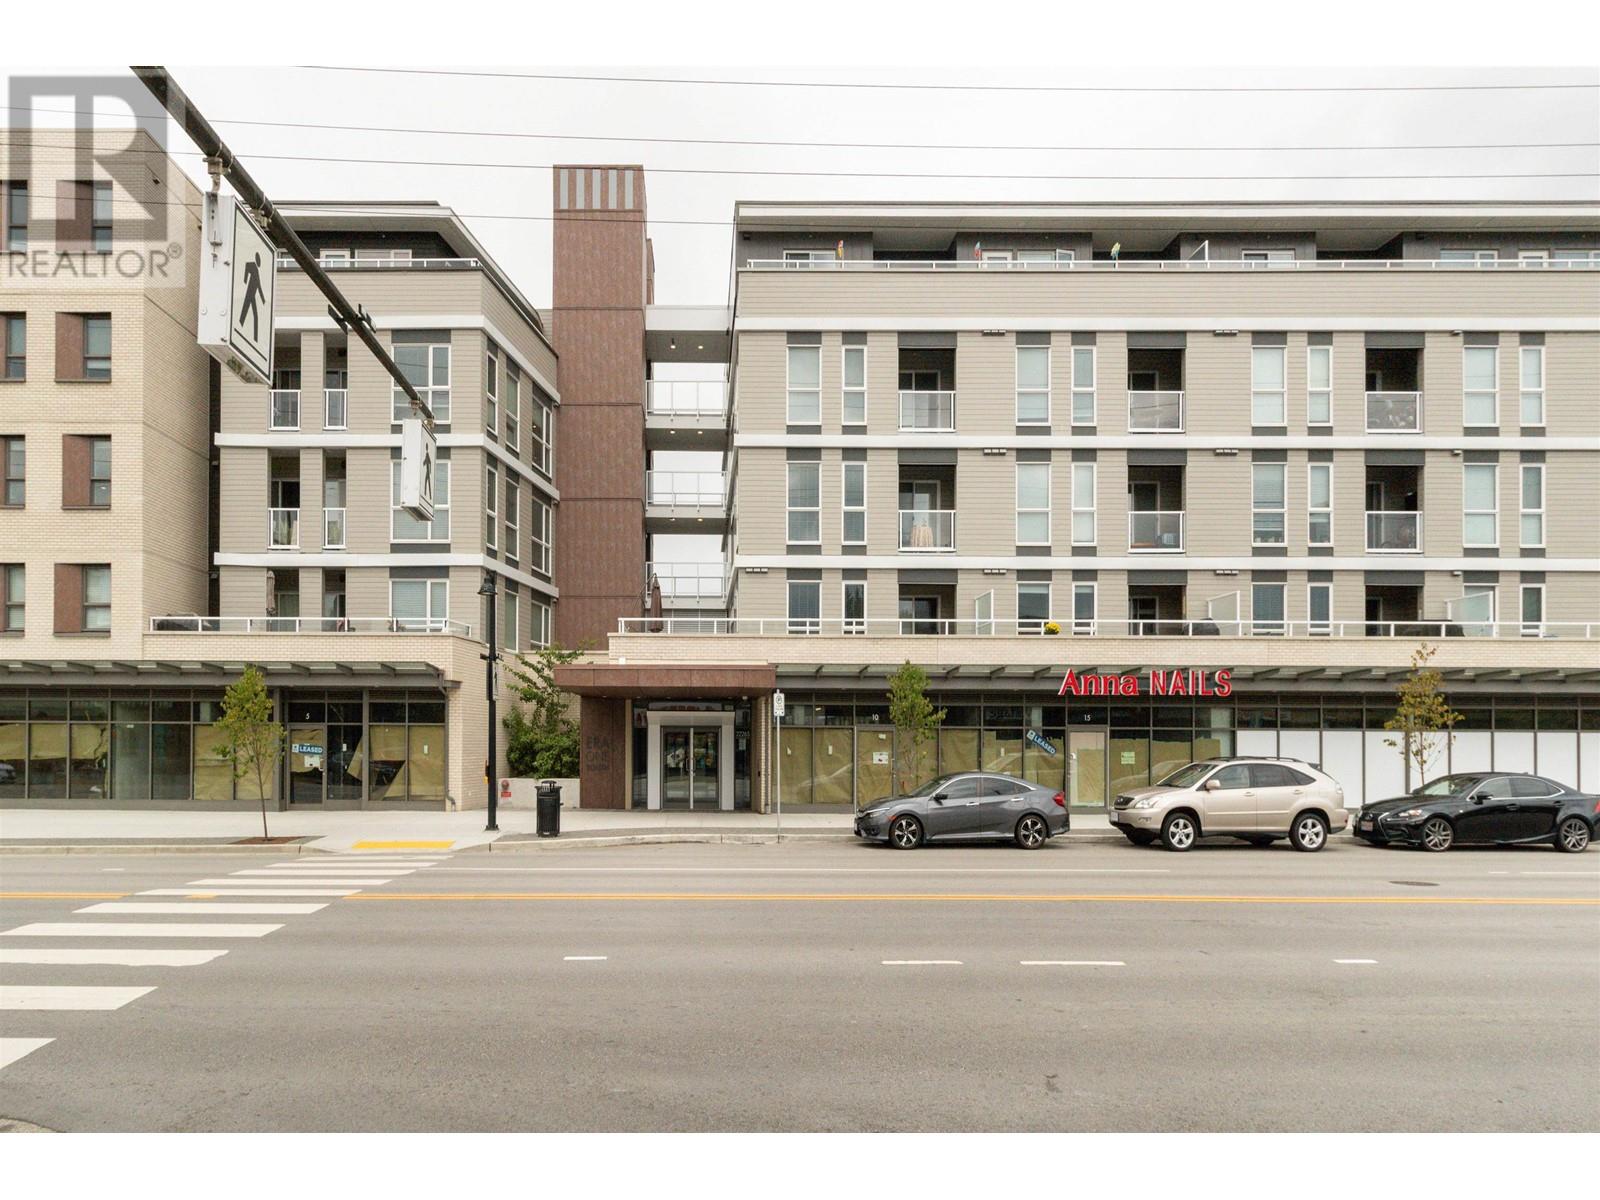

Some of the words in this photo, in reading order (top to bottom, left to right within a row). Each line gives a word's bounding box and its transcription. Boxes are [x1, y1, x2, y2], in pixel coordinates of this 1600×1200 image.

[1058, 668, 1139, 696] Anna
[1150, 670, 1232, 697] NAILS
[305, 712, 310, 720] 5
[299, 745, 323, 753] LEASED
[1034, 735, 1056, 754] LEASED
